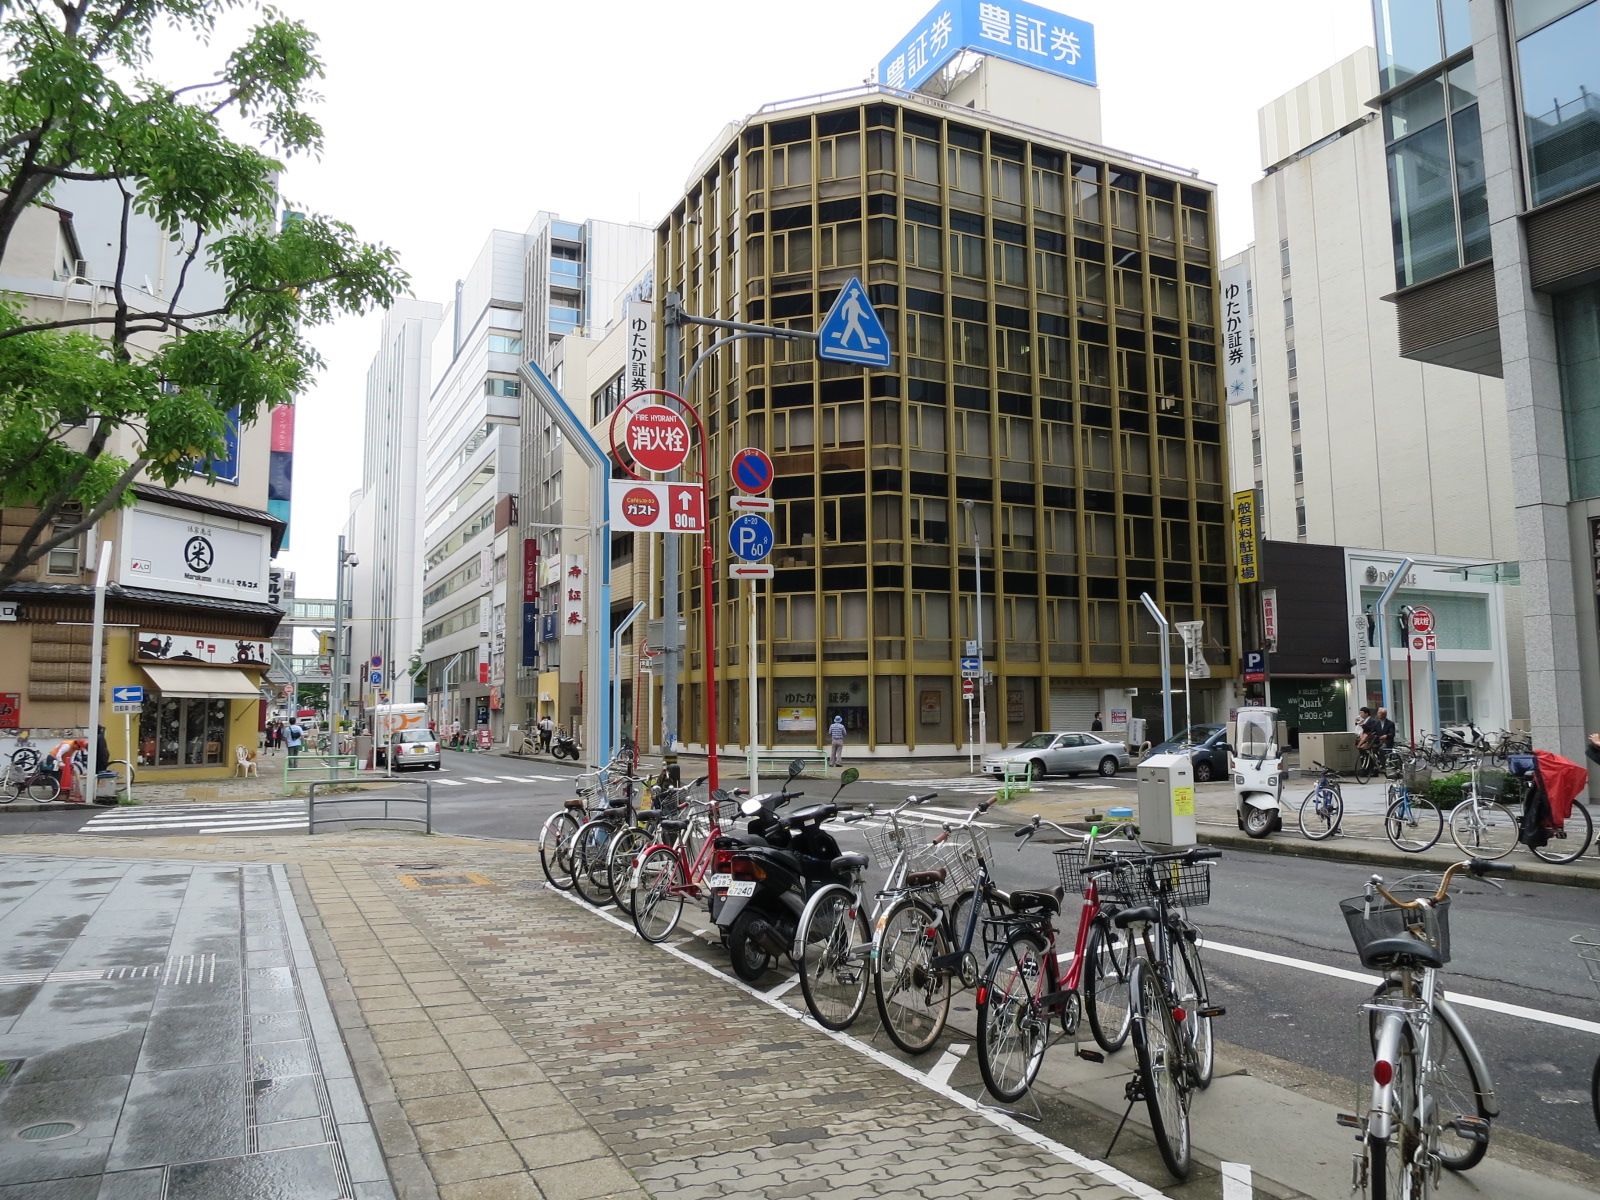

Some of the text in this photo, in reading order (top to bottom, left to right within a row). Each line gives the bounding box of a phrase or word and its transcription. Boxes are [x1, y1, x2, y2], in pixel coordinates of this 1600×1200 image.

[979, 2, 1081, 66] 豊証券
[886, 10, 953, 92] 豊証券
[1225, 283, 1244, 366] ゆたか証券
[631, 317, 647, 391] ゆたか証券
[635, 414, 679, 423] FIRE HYDRANT
[632, 425, 685, 452] 消火栓
[627, 504, 656, 516] ガスト
[674, 513, 696, 528] 90m
[743, 517, 758, 525] 8-20
[739, 527, 757, 556] P
[1236, 494, 1256, 580] 一般有料駐車場
[138, 563, 150, 571] 入口
[236, 580, 258, 589] マルコメ
[1263, 598, 1274, 636] 高額買取
[1248, 653, 1261, 668] P
[785, 691, 850, 704] ゆたか 証券
[1298, 697, 1323, 709] Quark
